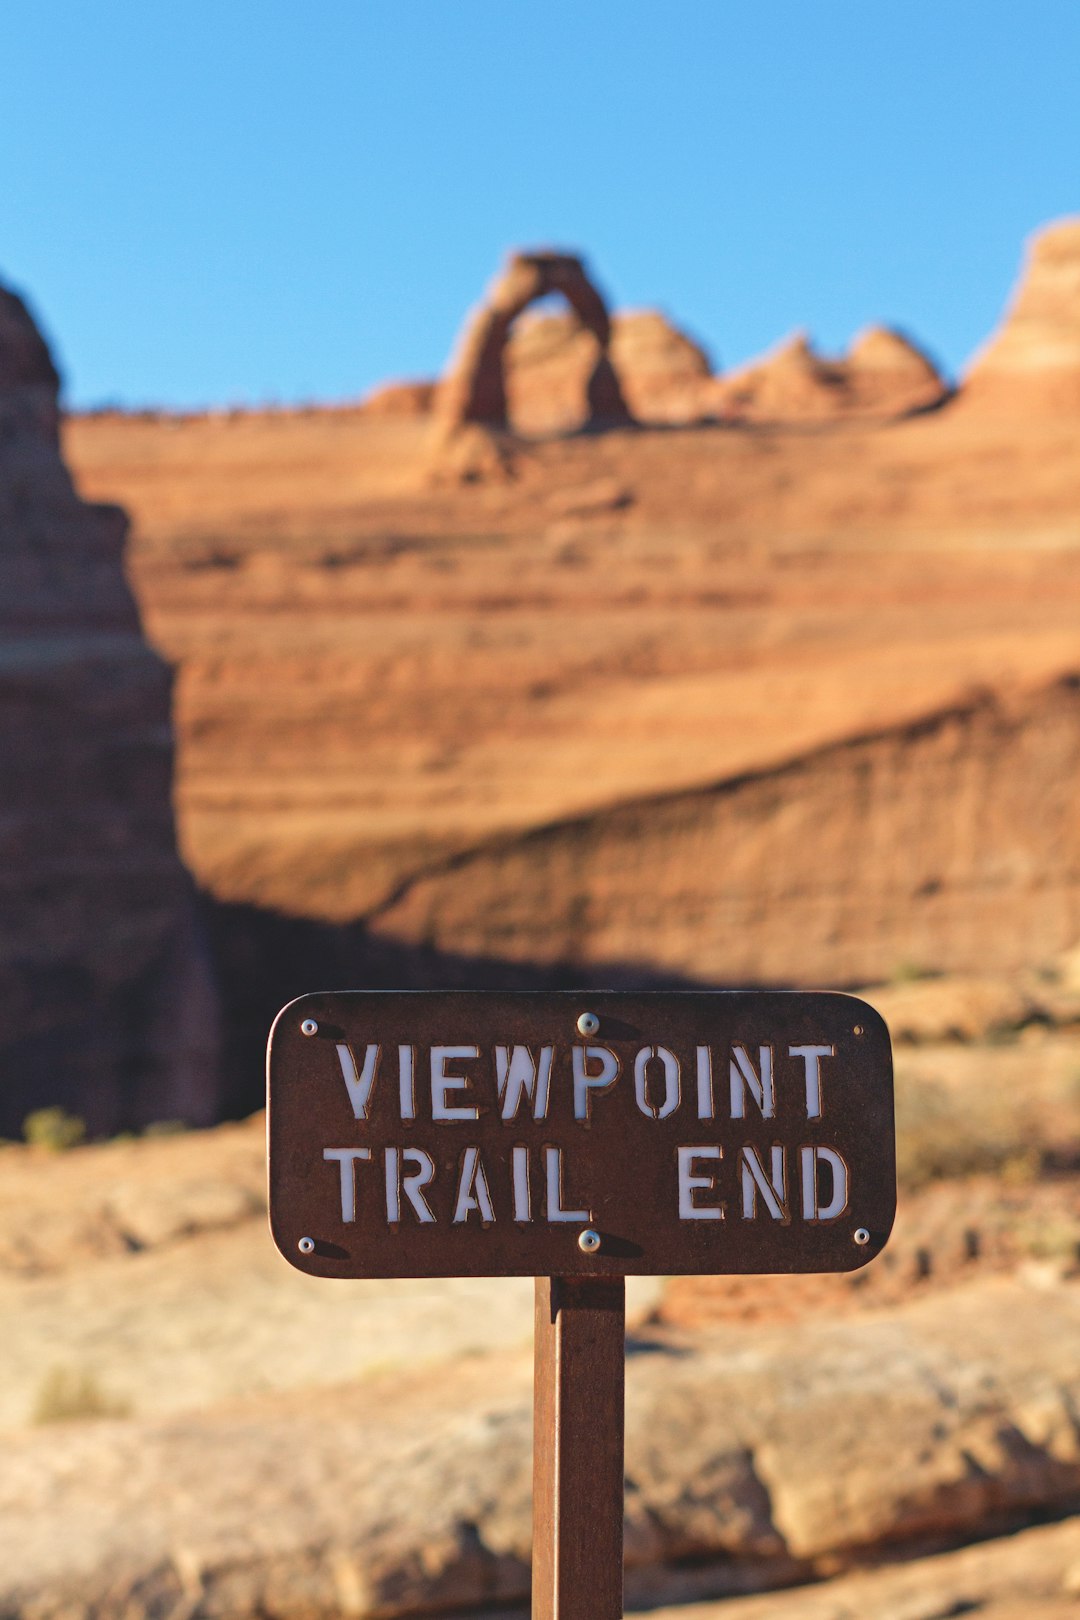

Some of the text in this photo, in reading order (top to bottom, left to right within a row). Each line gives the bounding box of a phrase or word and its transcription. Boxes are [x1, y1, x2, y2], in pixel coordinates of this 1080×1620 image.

[335, 1044, 837, 1121] VIEWPOINT
[322, 1144, 850, 1224] TRAIL END
